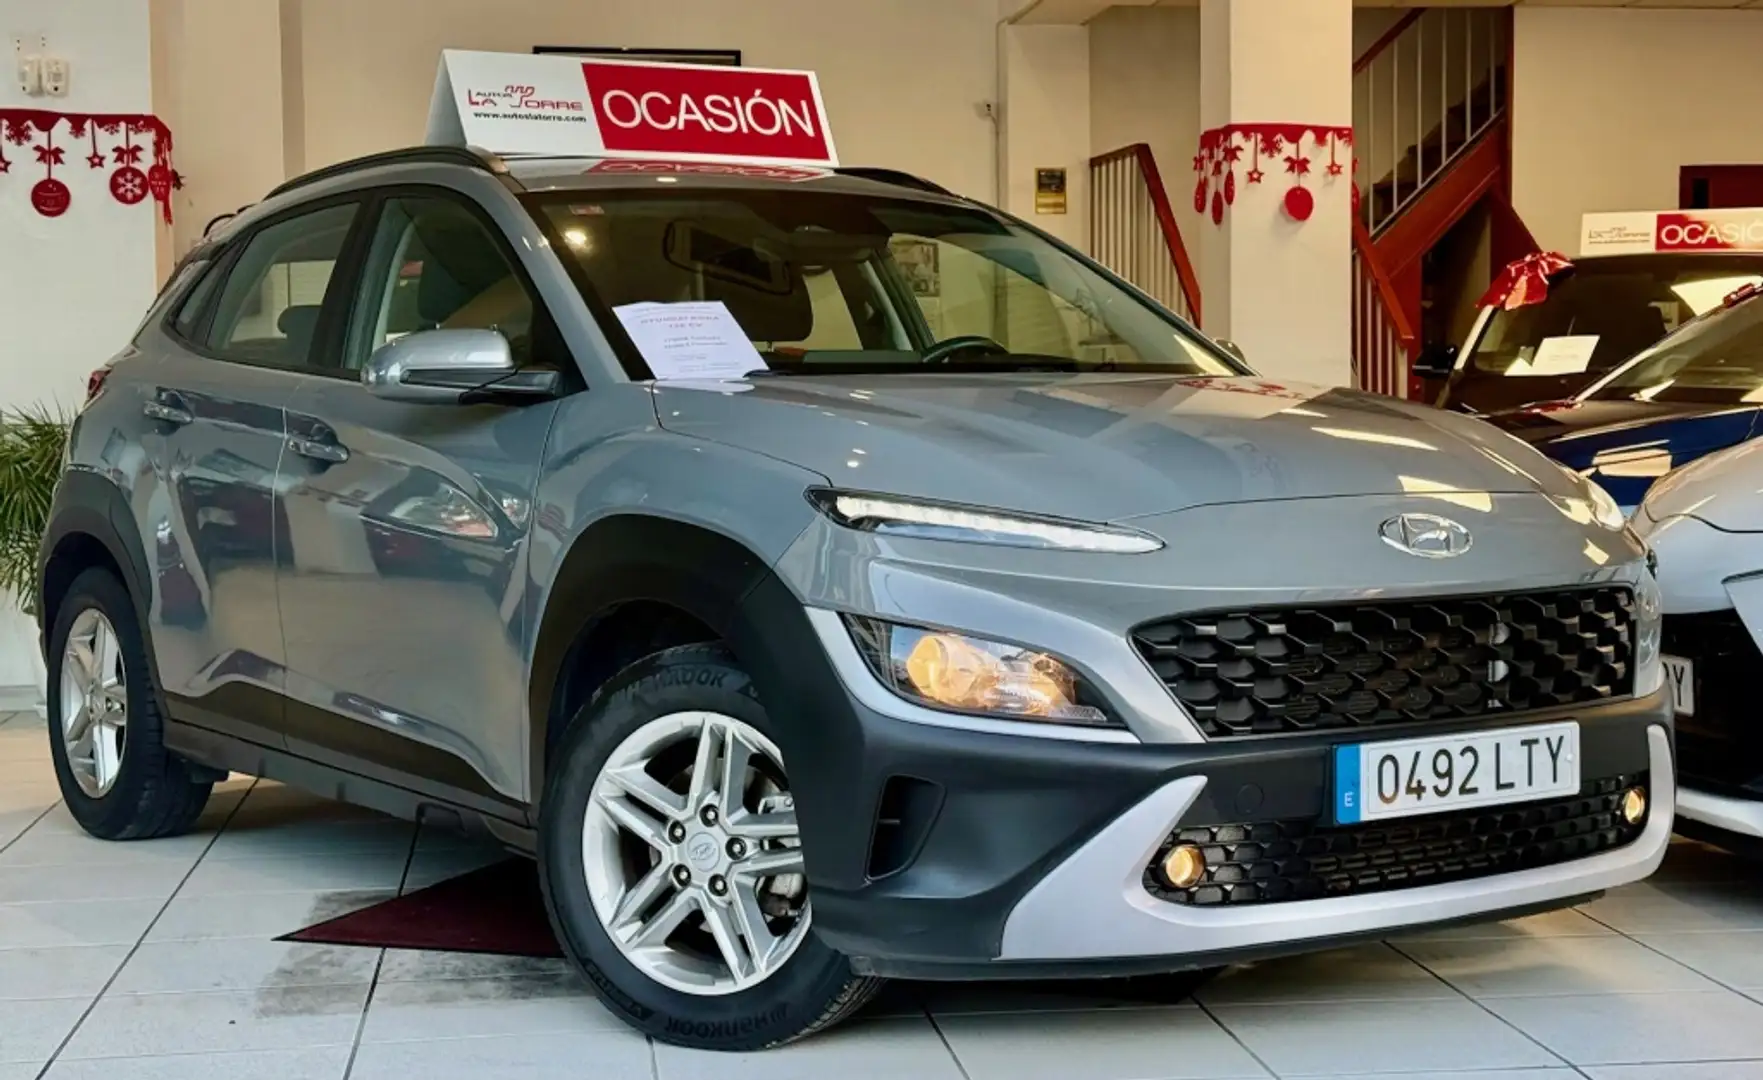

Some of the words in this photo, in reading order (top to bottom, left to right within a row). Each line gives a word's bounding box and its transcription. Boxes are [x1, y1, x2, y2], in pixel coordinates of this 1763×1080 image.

[602, 89, 815, 138] OCASIÓN
[1377, 745, 1480, 804] 0492
[1494, 735, 1565, 792] LTY
[1344, 791, 1355, 808] E
